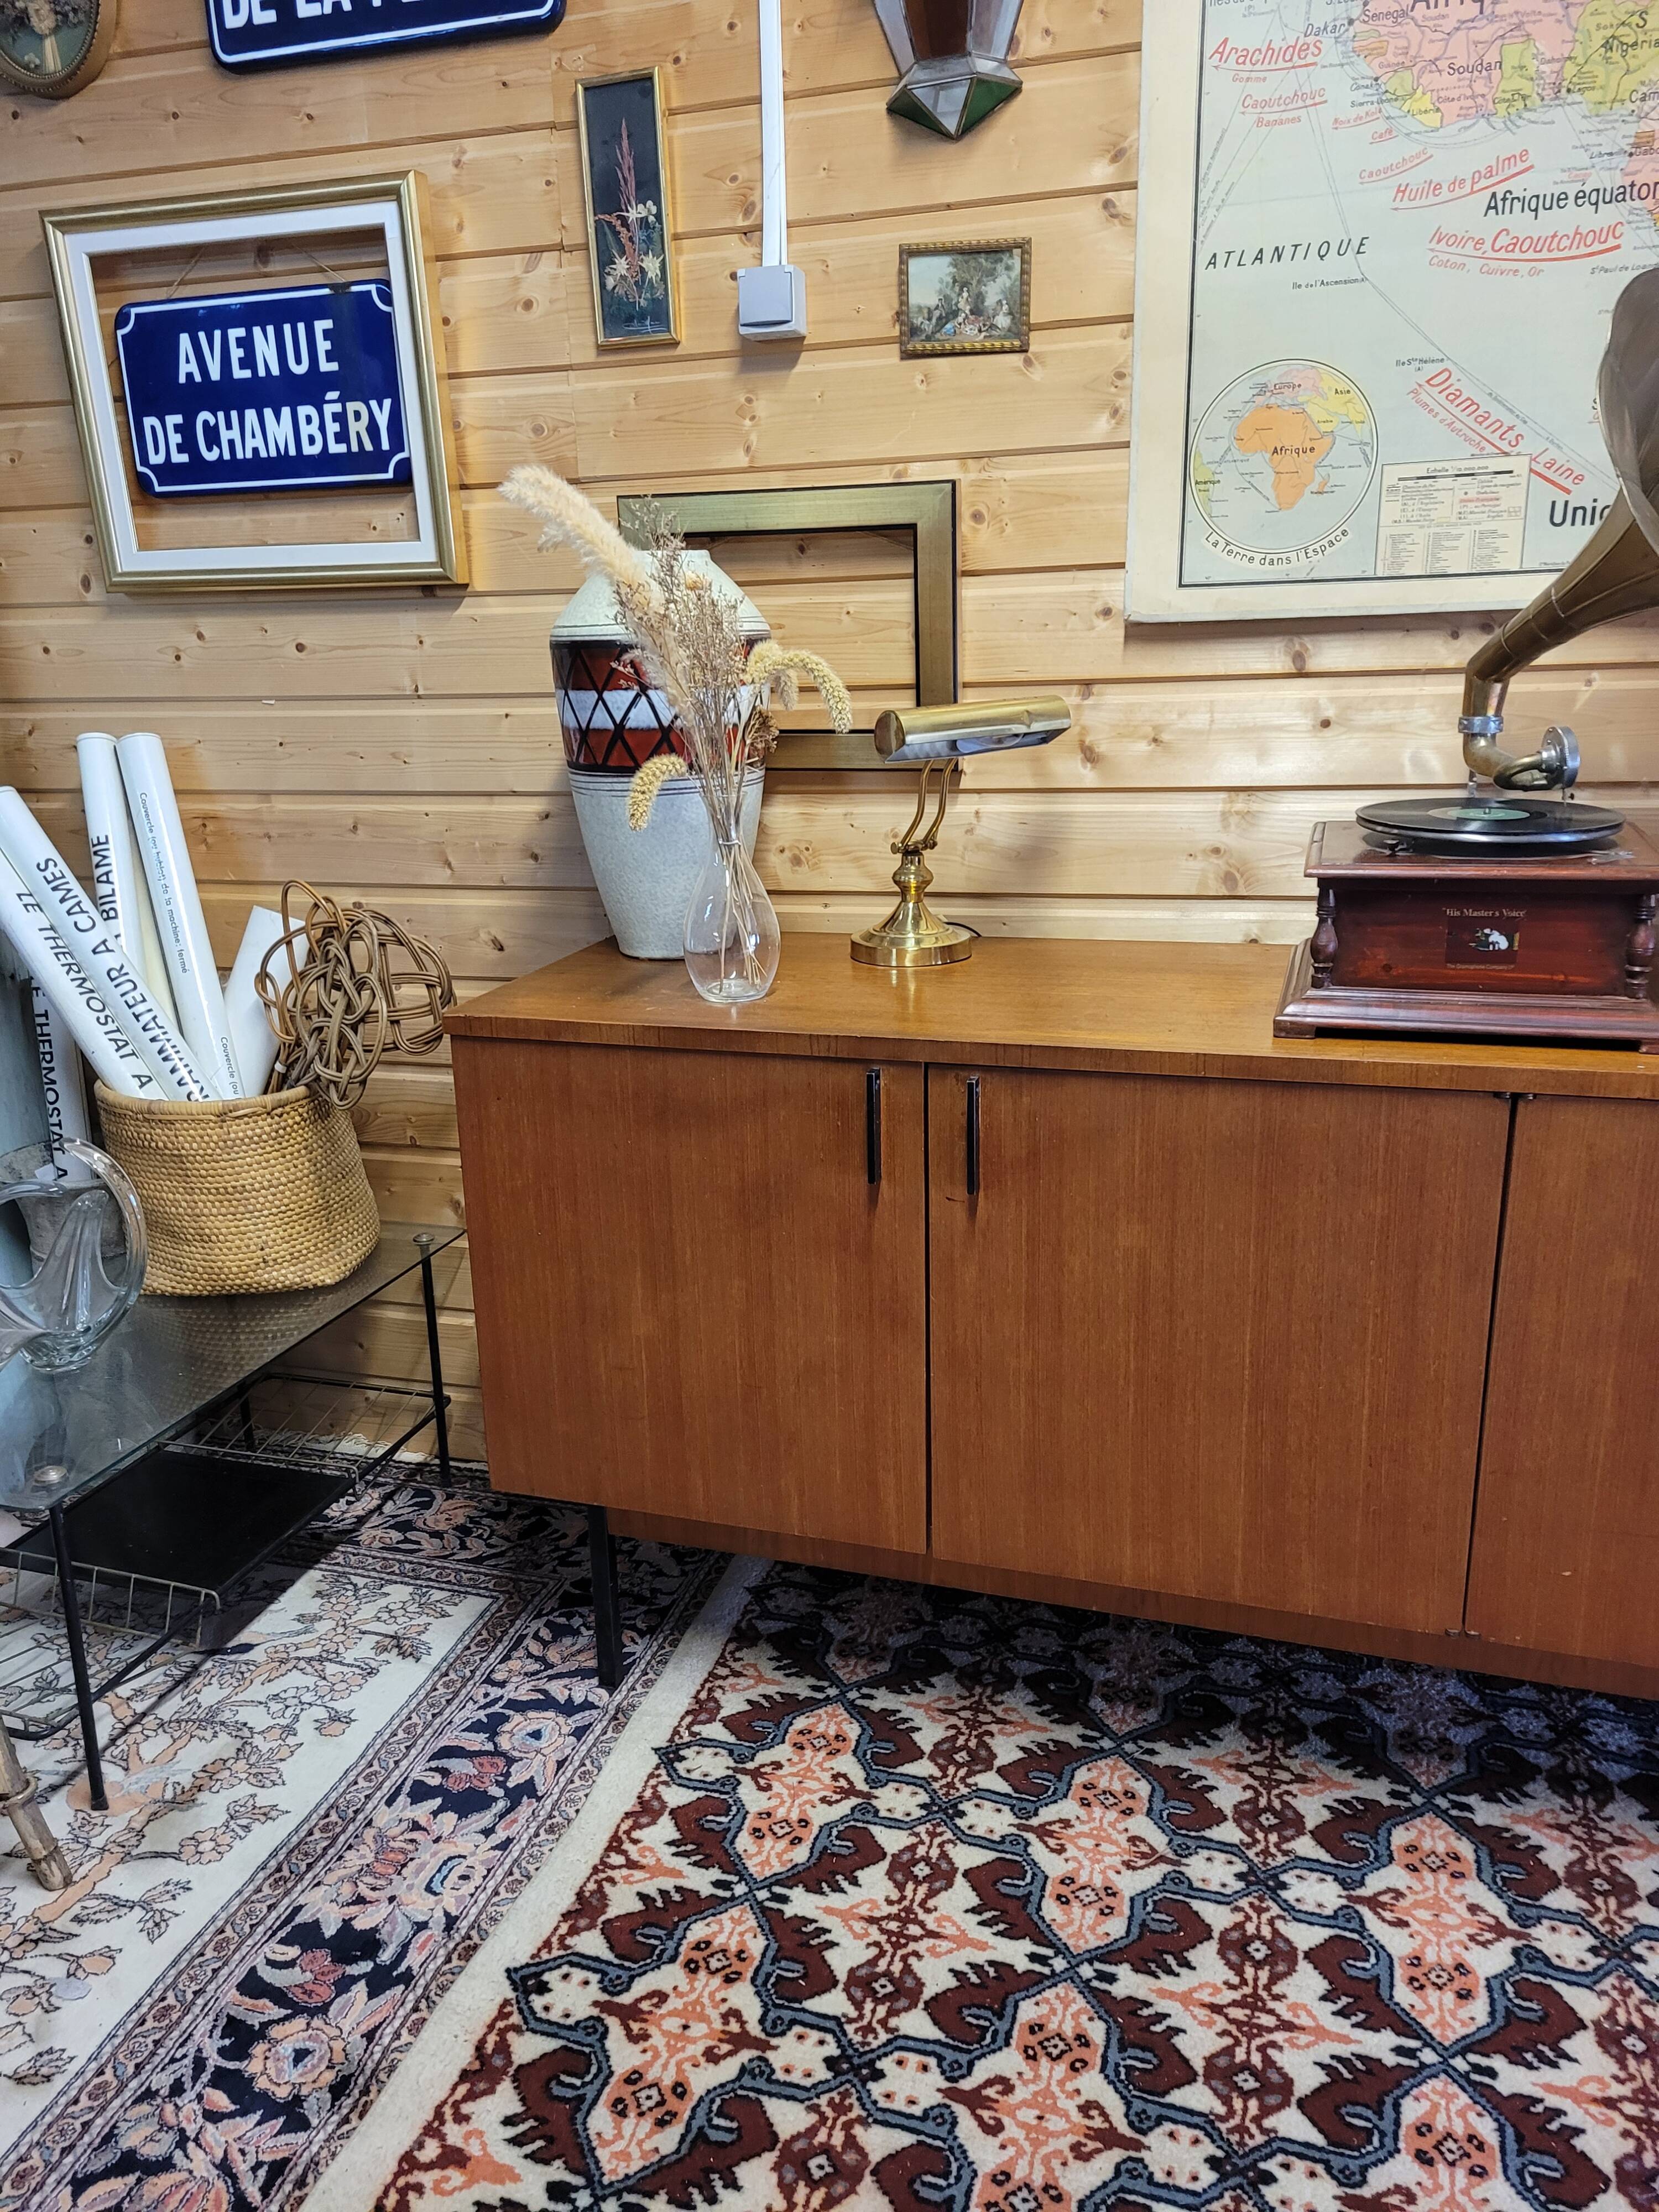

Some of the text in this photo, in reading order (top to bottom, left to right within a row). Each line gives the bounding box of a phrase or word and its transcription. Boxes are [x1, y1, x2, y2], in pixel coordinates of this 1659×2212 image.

[1304, 21, 1345, 38] Dakar
[1208, 36, 1323, 65] Arachides
[1232, 73, 1267, 83] Gomme
[1447, 59, 1502, 76] Soudan
[1241, 87, 1326, 109] Caoutchouc
[1256, 115, 1302, 128] Bananes
[1359, 147, 1428, 180] Caoutchouc
[1392, 149, 1529, 202] Huile de palme
[1484, 189, 1569, 220] Afrique
[1204, 236, 1370, 270] ATLANTIQUE
[1491, 221, 1625, 254] Caoutchouc
[1527, 265, 1545, 277] Or
[179, 319, 339, 384] AVENUE
[1274, 383, 1302, 391] Europe
[1406, 388, 1486, 453] Plumes d'Autruche
[1425, 368, 1525, 448] Diamants
[143, 391, 392, 465] DE CHAMBÉRY
[1272, 445, 1316, 458] Afrique
[1531, 447, 1585, 486] Laine
[1205, 528, 1349, 566] La Terre dans l'Espace
[91, 834, 118, 922] BILAME
[140, 792, 155, 834] Couvercle
[168, 909, 181, 947] machine:
[177, 949, 190, 974] fermé
[36, 858, 96, 933] CAMES
[92, 940, 116, 956] A
[16, 891, 154, 1090] LE THERMOSTAT A
[221, 1037, 236, 1078] Couvercle
